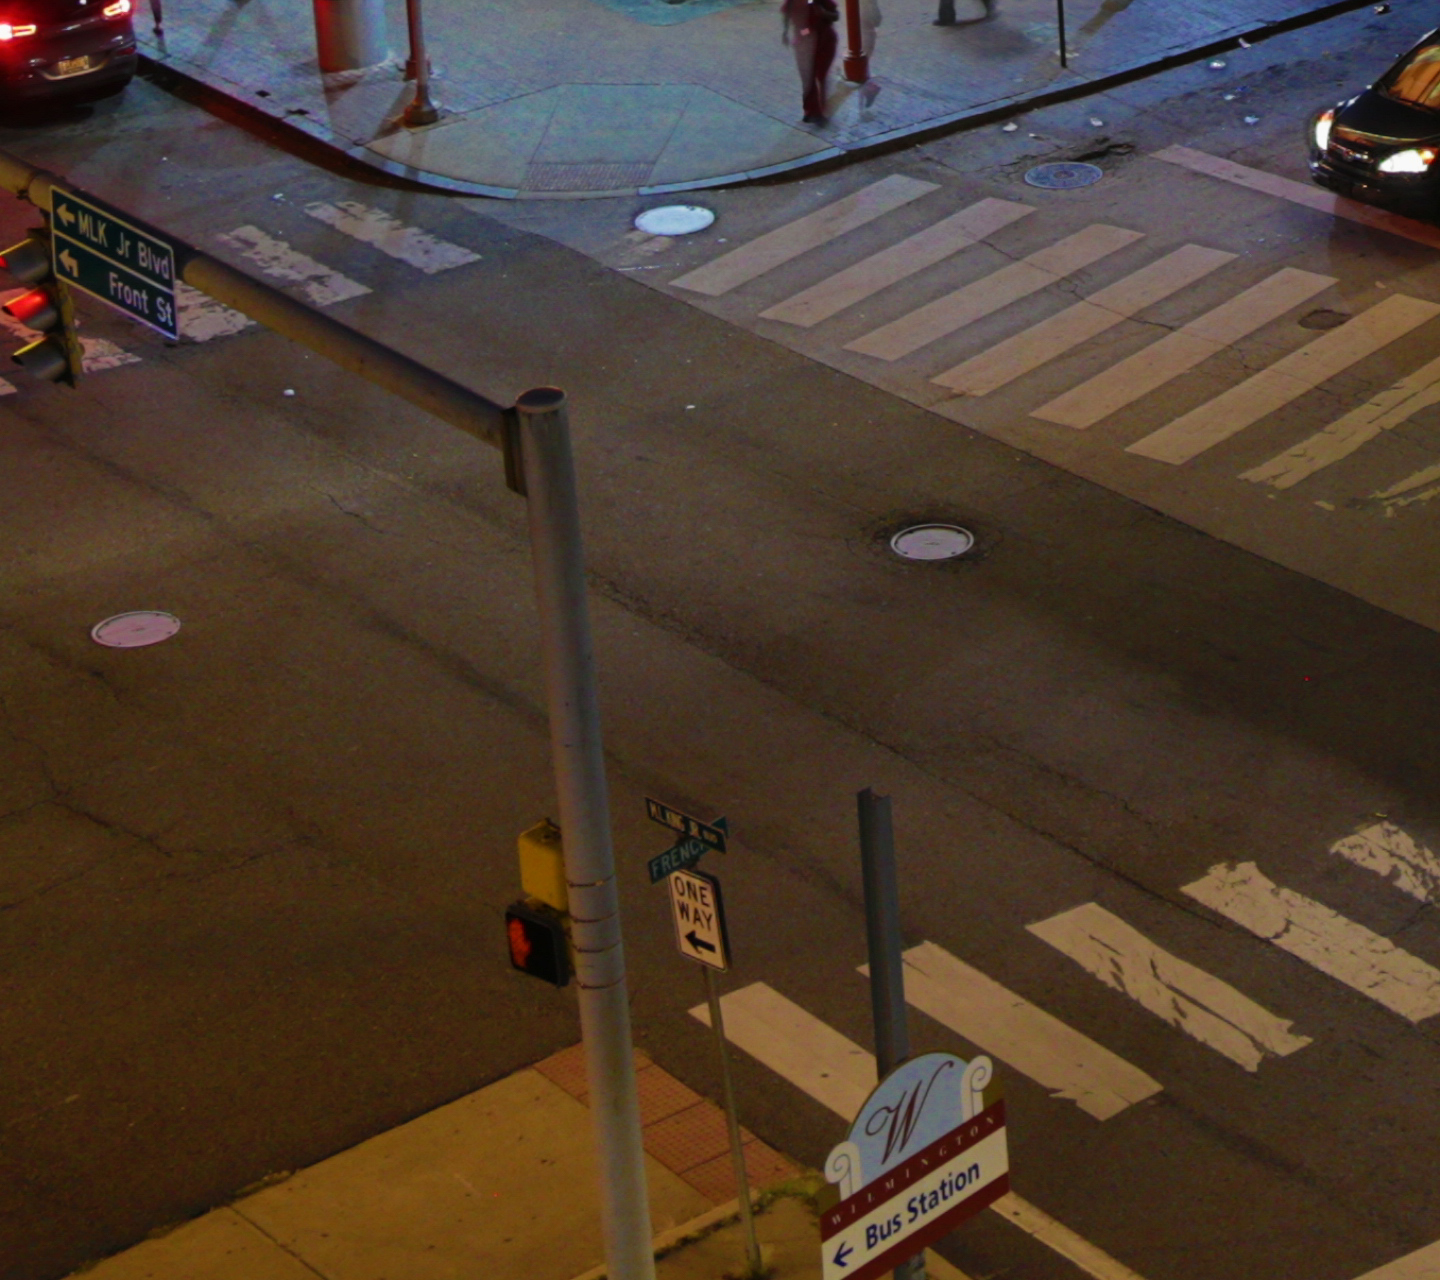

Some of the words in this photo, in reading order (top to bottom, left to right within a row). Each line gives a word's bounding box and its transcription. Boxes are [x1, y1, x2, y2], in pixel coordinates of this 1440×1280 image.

[78, 210, 108, 248] MLK
[116, 232, 131, 258] Jr
[138, 241, 170, 280] Blvd
[109, 271, 149, 315] Front
[156, 297, 174, 327] St
[674, 875, 711, 907] ONE
[677, 899, 714, 932] WAY
[865, 1060, 954, 1166] W
[831, 1115, 996, 1226] WILMINGTON
[866, 1217, 902, 1251] Bus
[907, 1162, 981, 1225] Station
